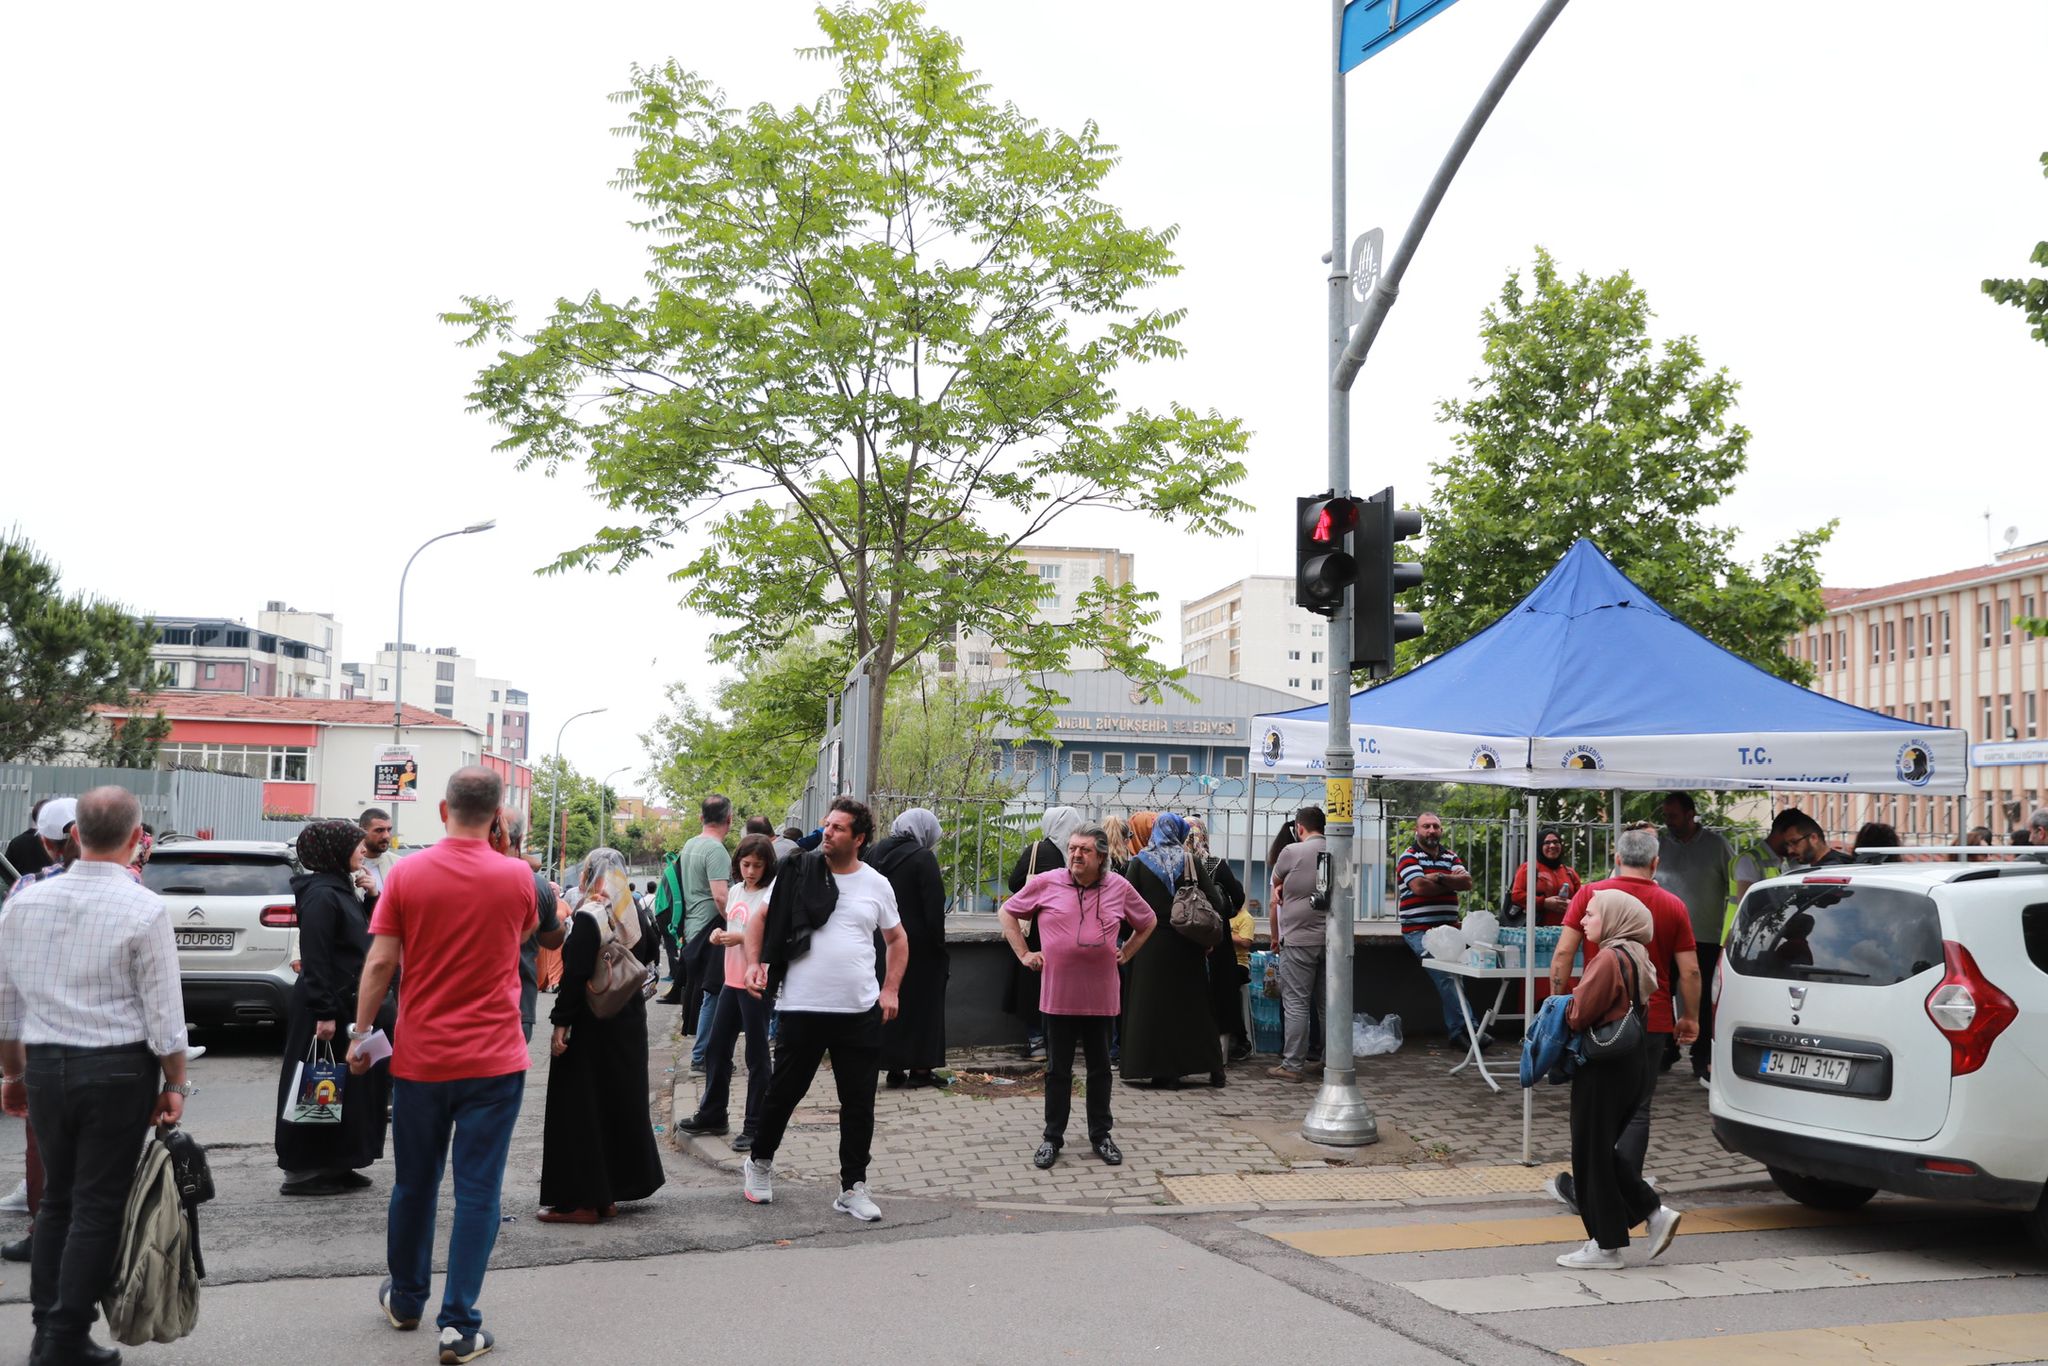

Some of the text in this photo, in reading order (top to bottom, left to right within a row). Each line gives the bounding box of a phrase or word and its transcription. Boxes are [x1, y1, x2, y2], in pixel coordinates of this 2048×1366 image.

[1096, 714, 1168, 736] BÜYÜKŞEHİR
[1171, 718, 1236, 735] BELEDİYESİ
[1358, 737, 1381, 754] T.C.
[1577, 744, 1605, 769] BELEDİYES
[1738, 747, 1772, 765] T.C.
[1769, 1053, 1846, 1080] 34 DH 3147
